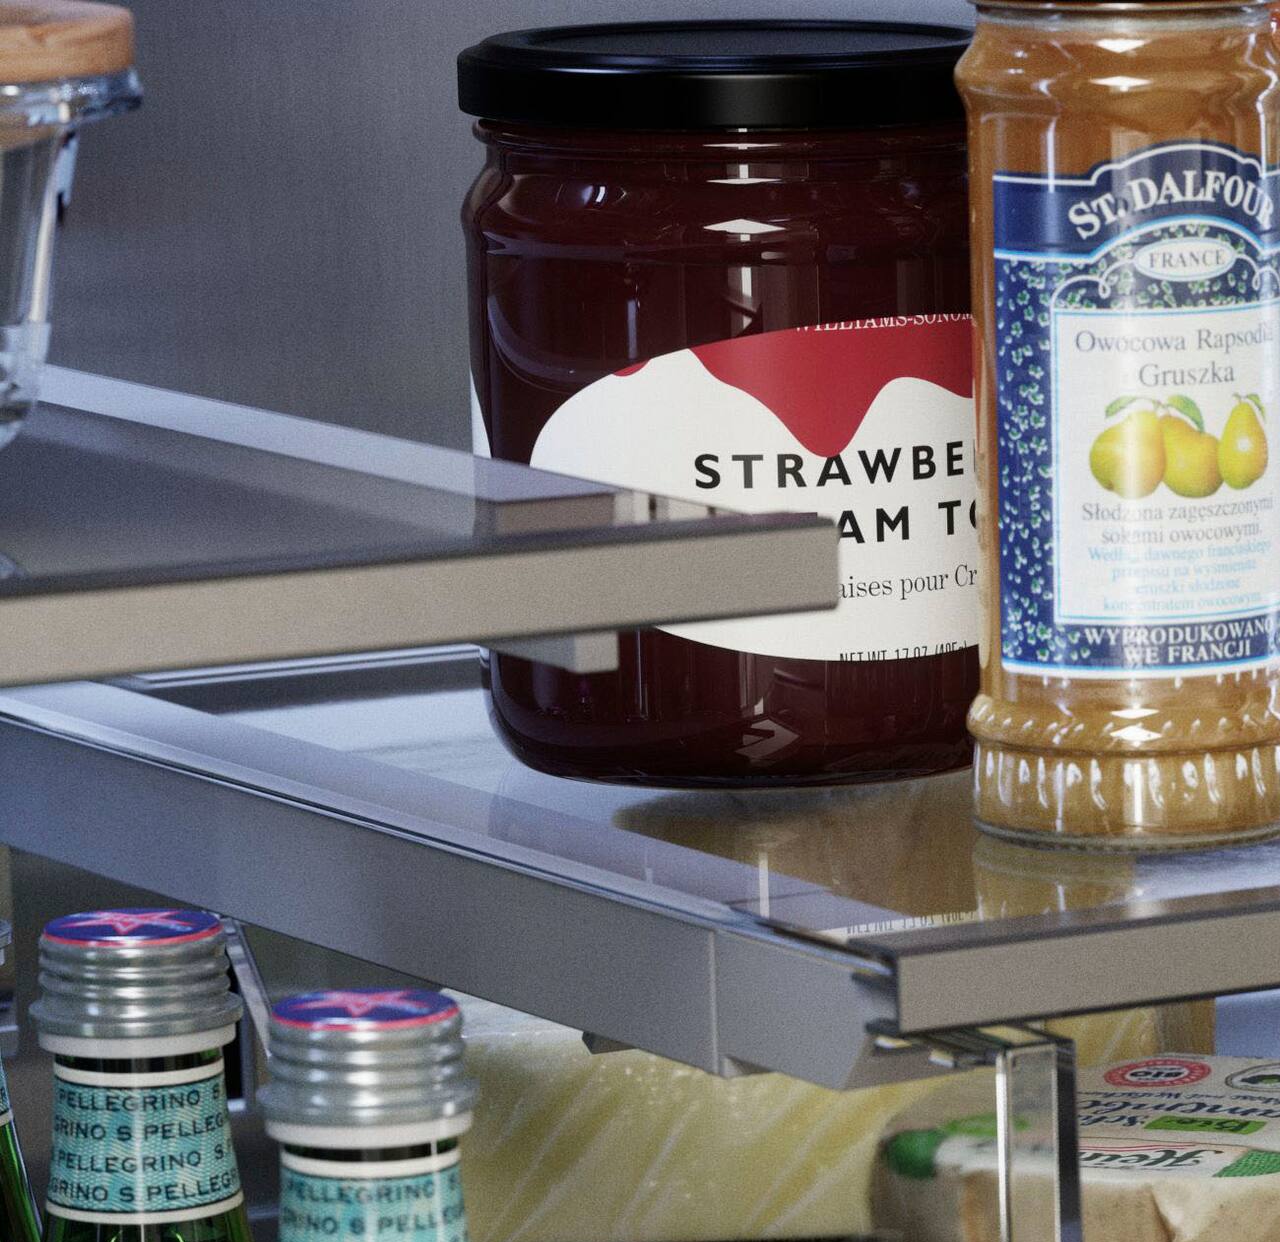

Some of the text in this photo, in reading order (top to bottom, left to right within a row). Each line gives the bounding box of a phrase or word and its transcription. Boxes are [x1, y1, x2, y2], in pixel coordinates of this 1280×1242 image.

[1068, 169, 1274, 239] ST. DALFOUR
[1149, 248, 1225, 270] FRANCE
[1074, 330, 1186, 353] Owocowa
[1138, 361, 1235, 388] Gruszka
[694, 440, 976, 491] STRAWBE
[837, 506, 909, 544] AM
[900, 573, 949, 600] pour
[1083, 616, 1275, 646] WYPRODUKOWANO
[1124, 640, 1251, 664] WE FRANCJI
[116, 1125, 132, 1142] S
[119, 1185, 136, 1202] S
